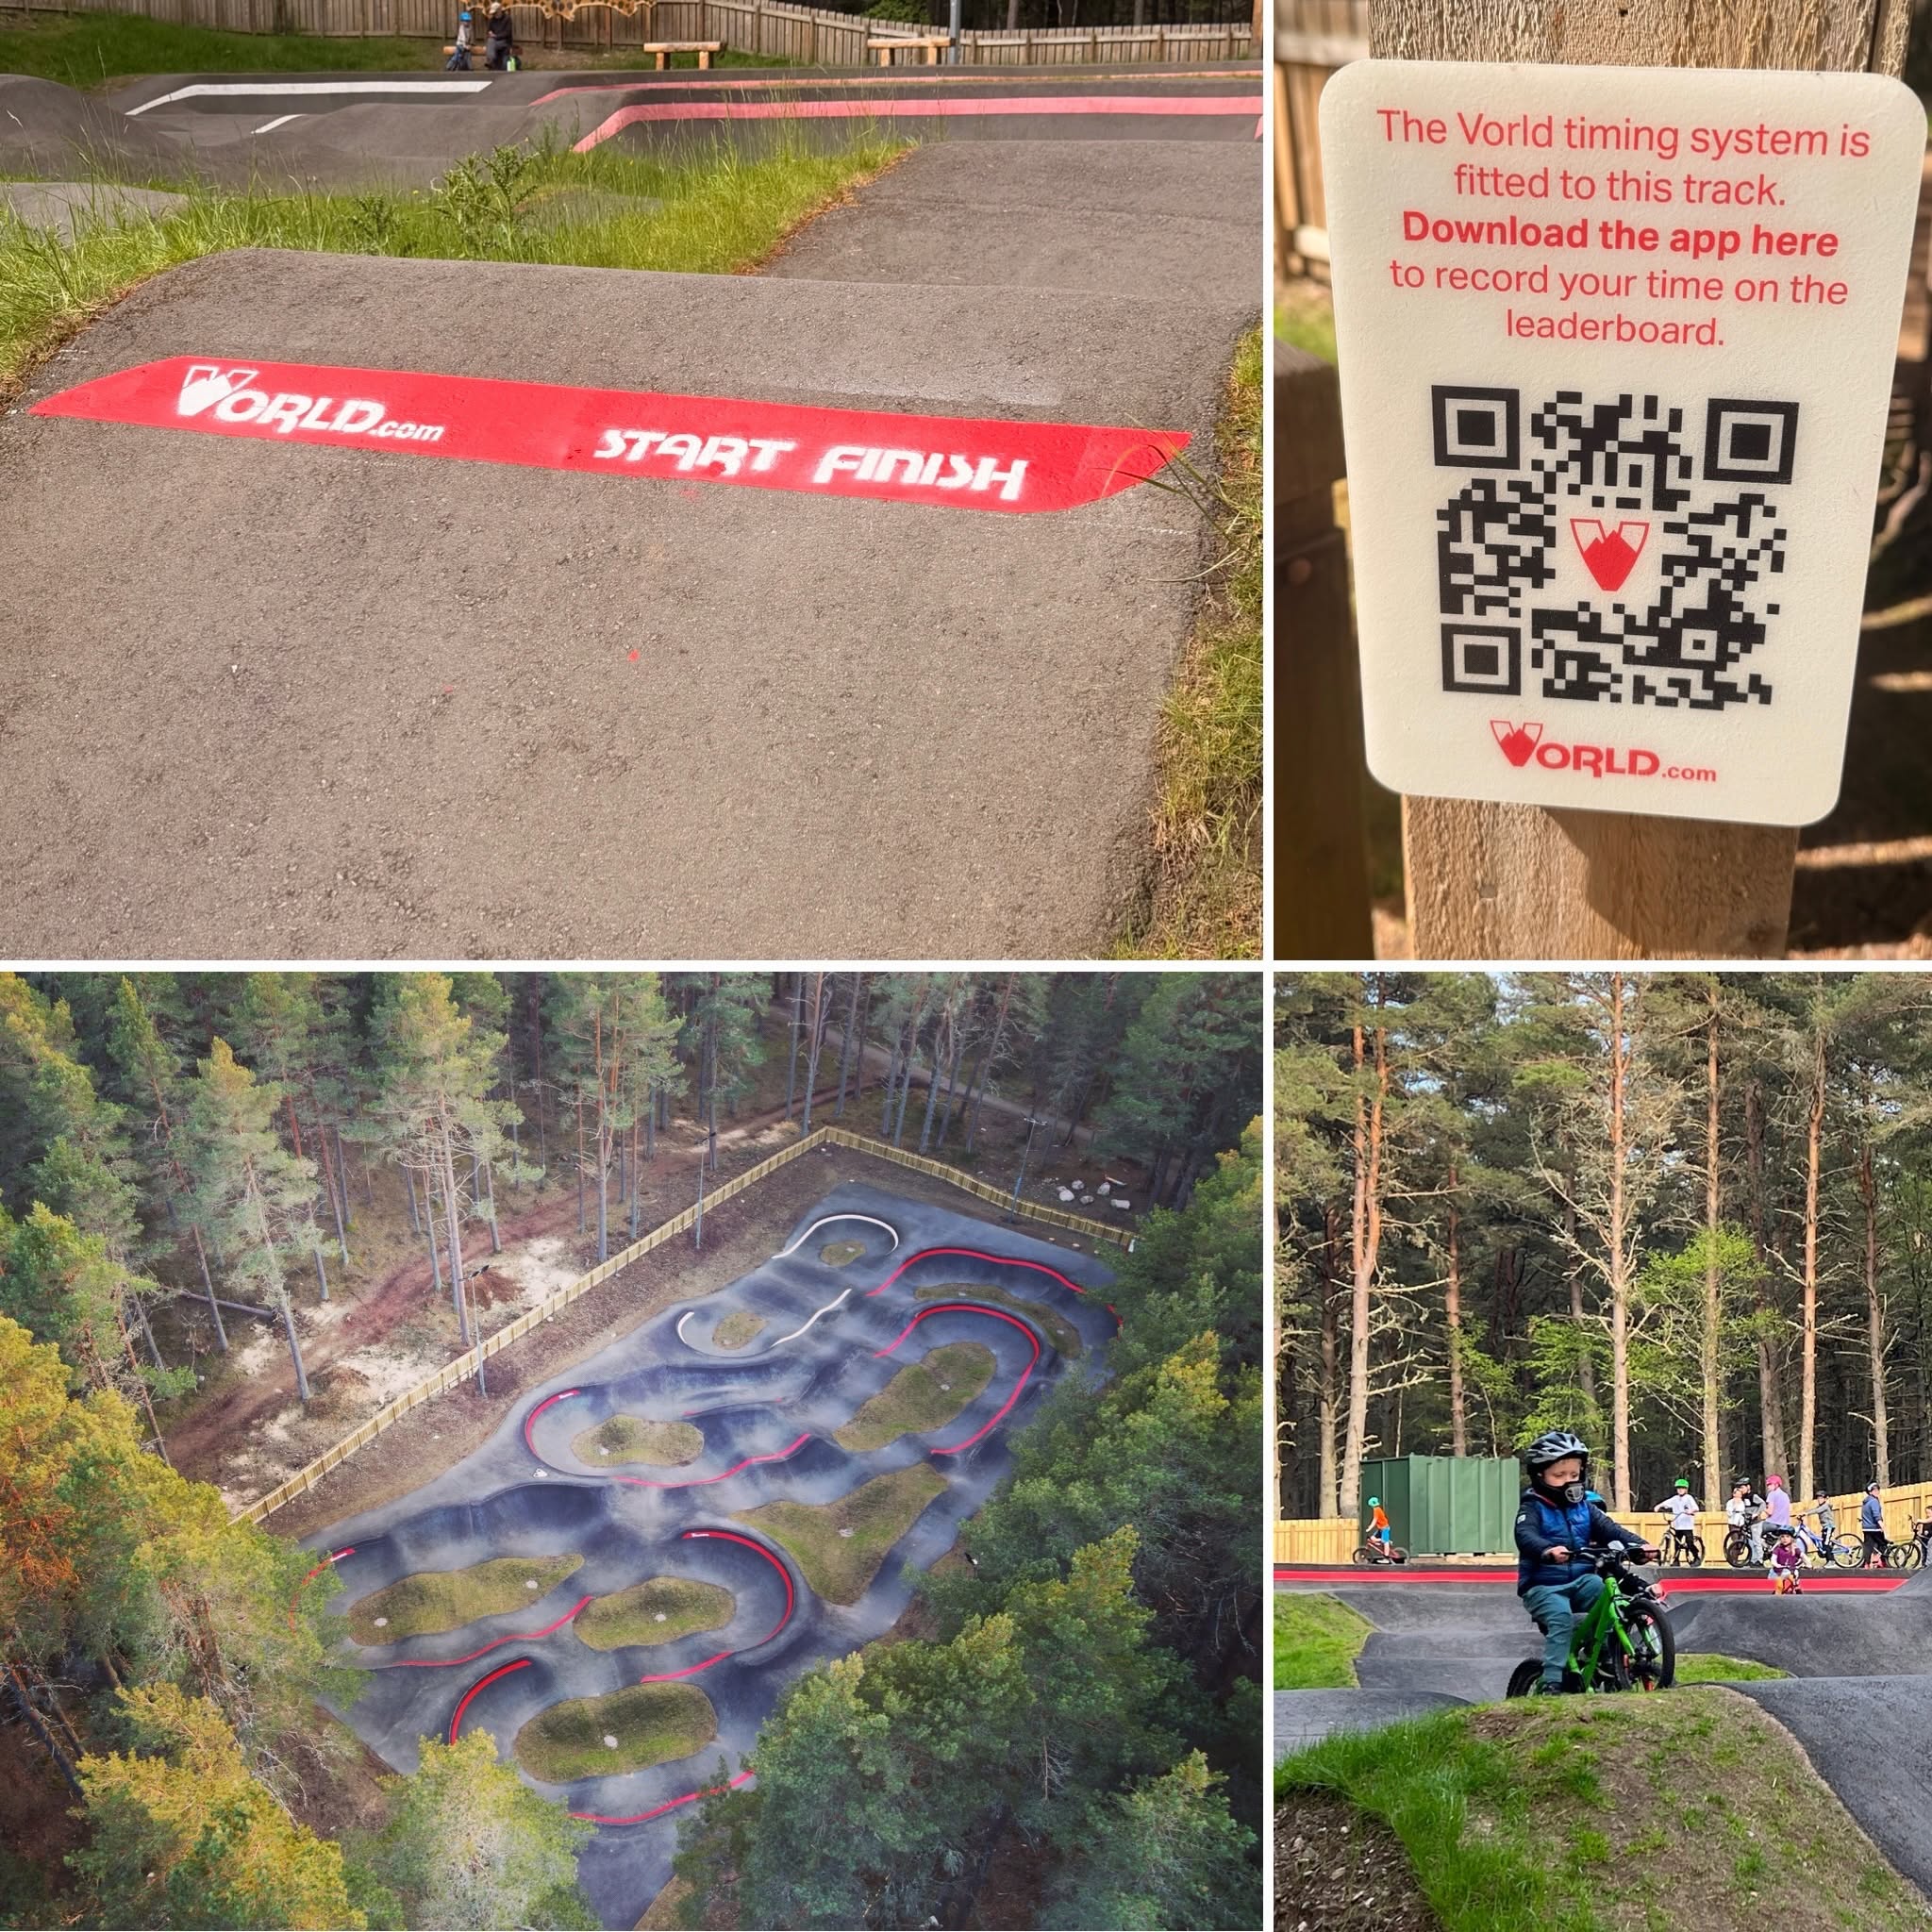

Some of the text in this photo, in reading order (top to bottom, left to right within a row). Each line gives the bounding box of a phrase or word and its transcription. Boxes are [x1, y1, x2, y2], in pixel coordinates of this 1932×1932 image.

[1376, 107, 1872, 162] The Vorld timing system is
[1453, 161, 1787, 208] fitted to this track.
[1402, 208, 1840, 262] Download the app here
[1389, 258, 1850, 307] to record your time on the
[1506, 307, 1726, 347] leaderboard.
[593, 429, 1028, 501] START FINISH
